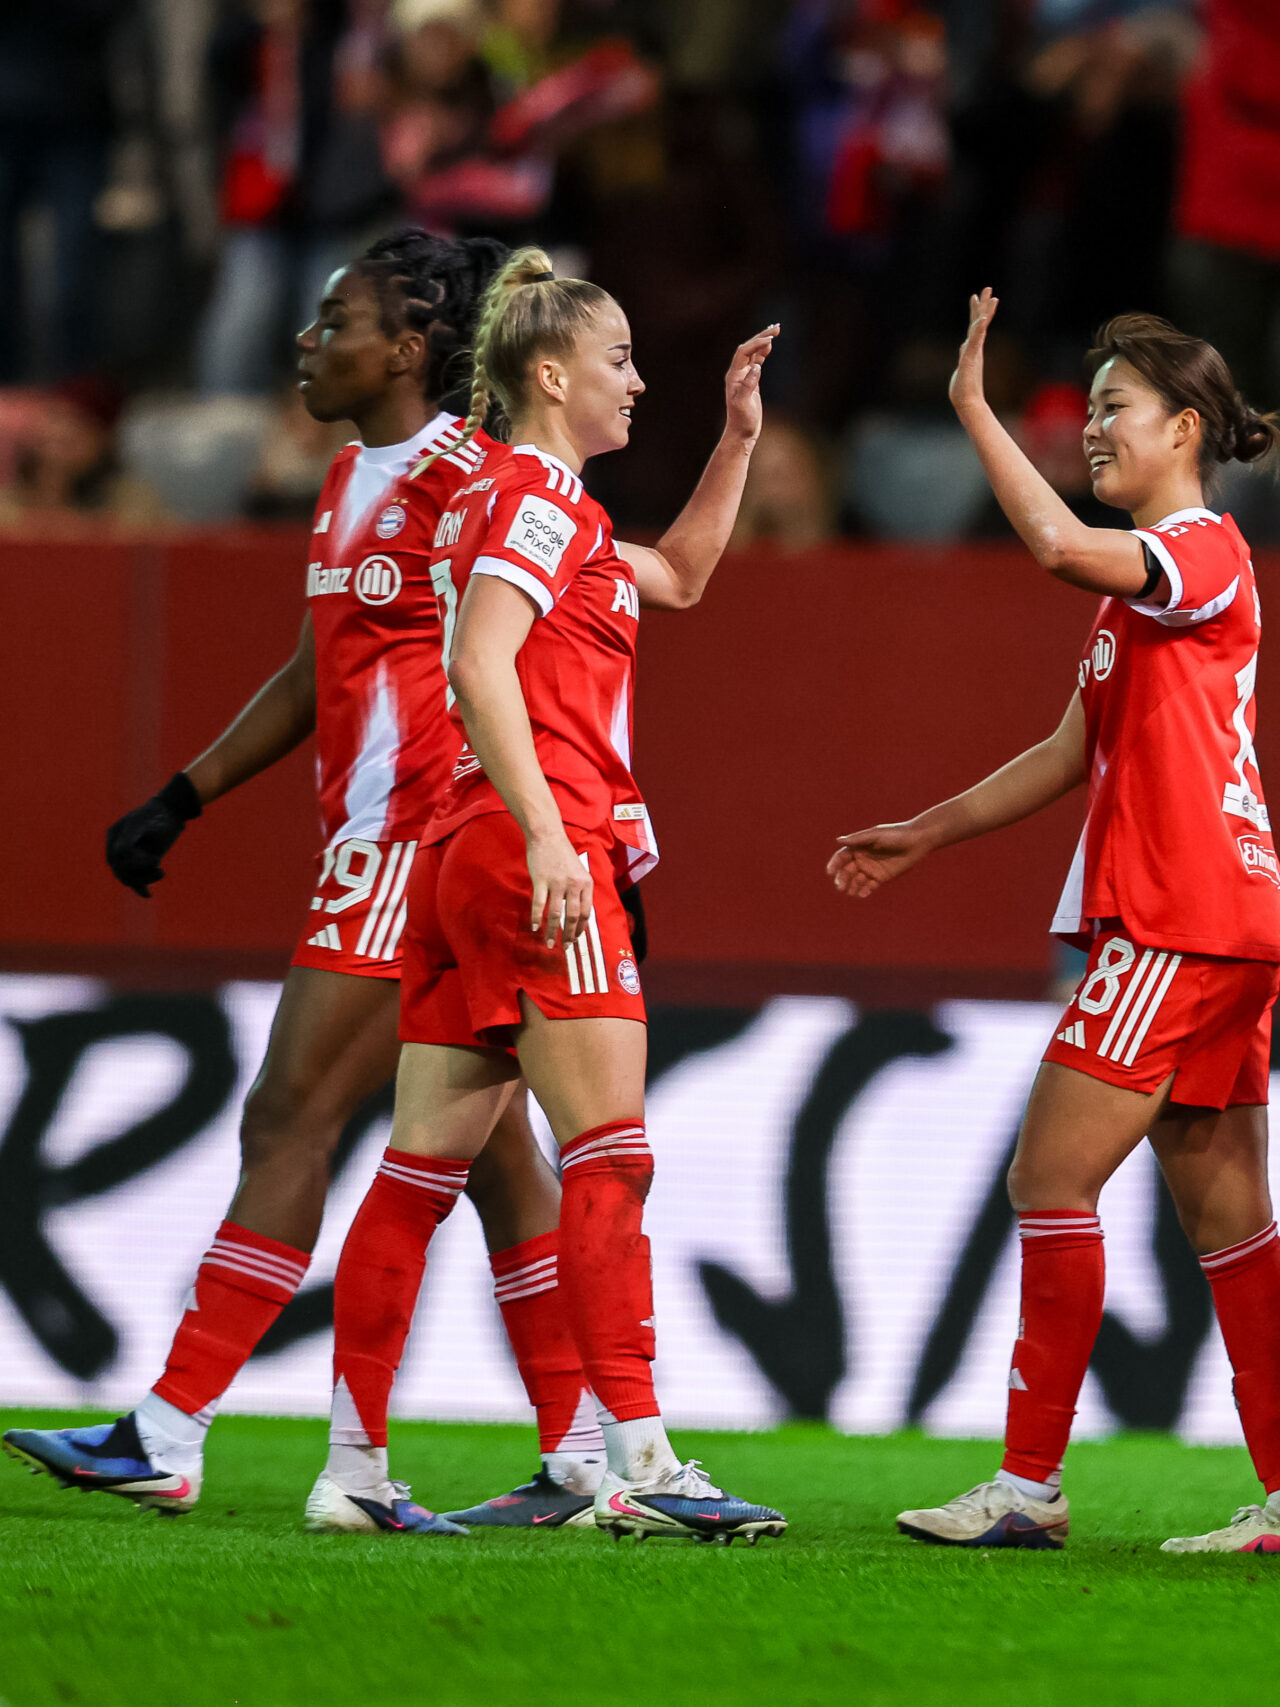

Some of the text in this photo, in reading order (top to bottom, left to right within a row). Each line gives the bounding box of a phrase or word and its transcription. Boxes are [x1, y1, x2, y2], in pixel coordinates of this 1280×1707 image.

[521, 510, 565, 549] Google
[523, 528, 556, 558] Pixel
[1069, 936, 1136, 1016] 8
